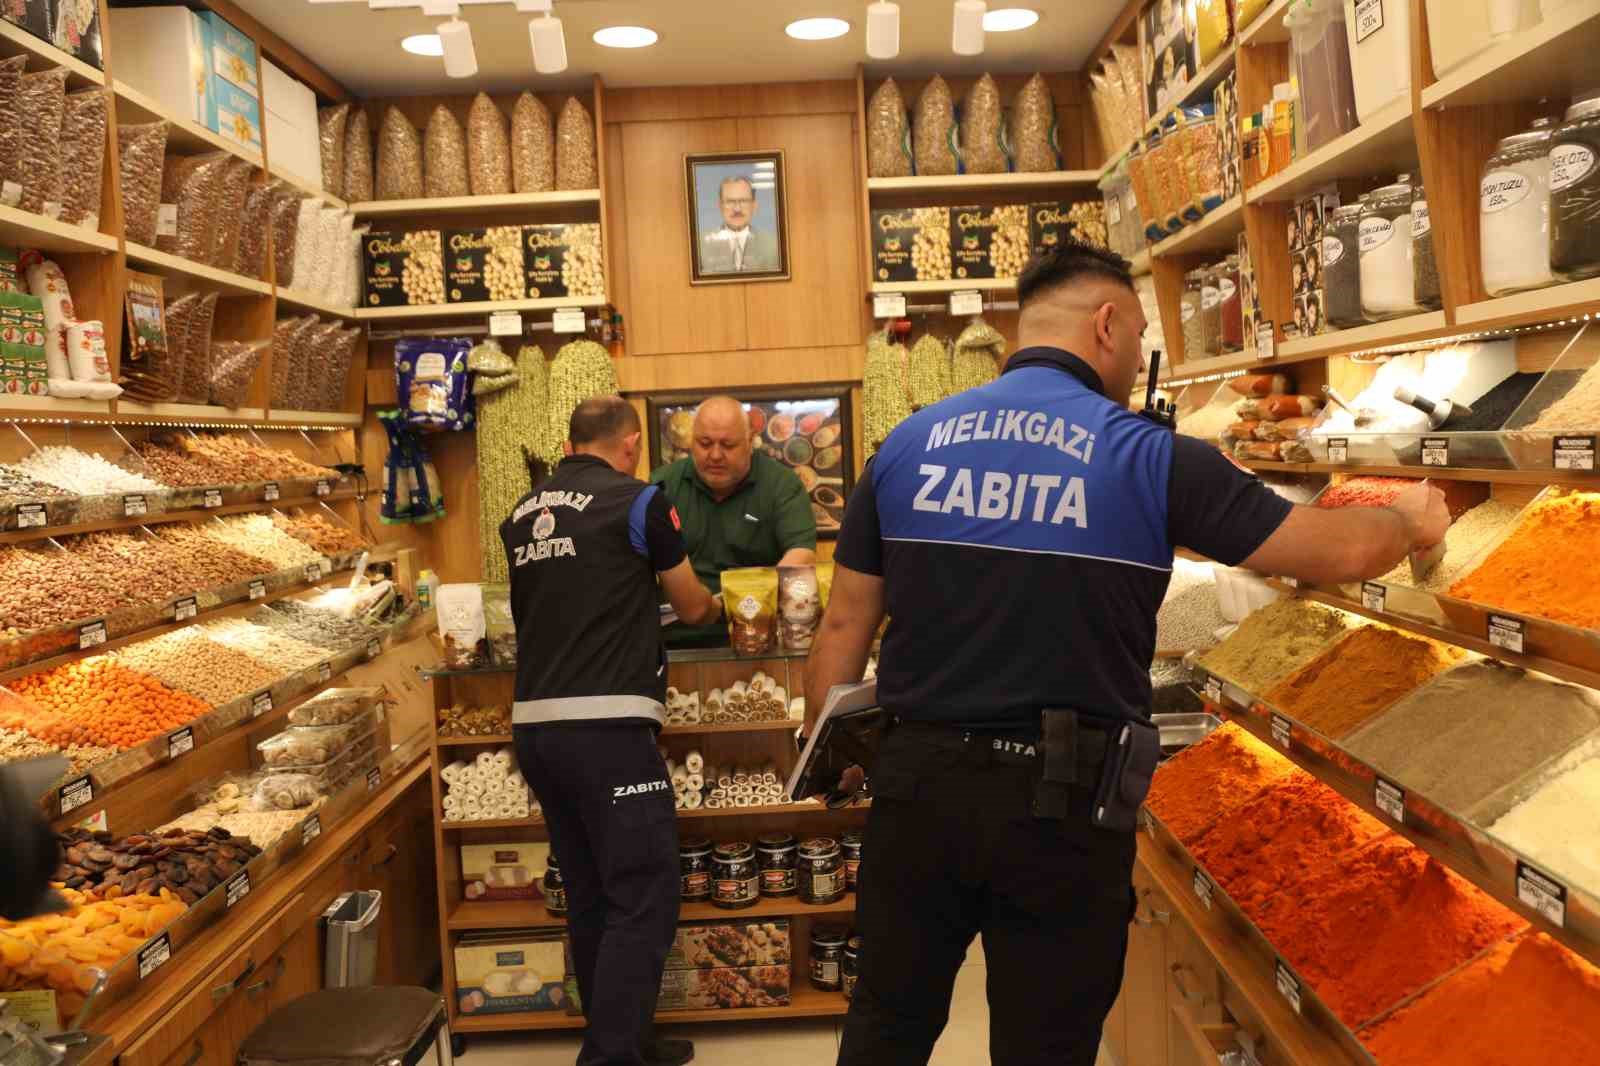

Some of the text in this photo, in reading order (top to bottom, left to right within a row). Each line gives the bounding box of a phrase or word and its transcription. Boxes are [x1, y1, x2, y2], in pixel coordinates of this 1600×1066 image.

[912, 463, 1088, 529] ZABITA
[513, 536, 577, 567] ZABITA
[613, 779, 669, 798] ZABITA
